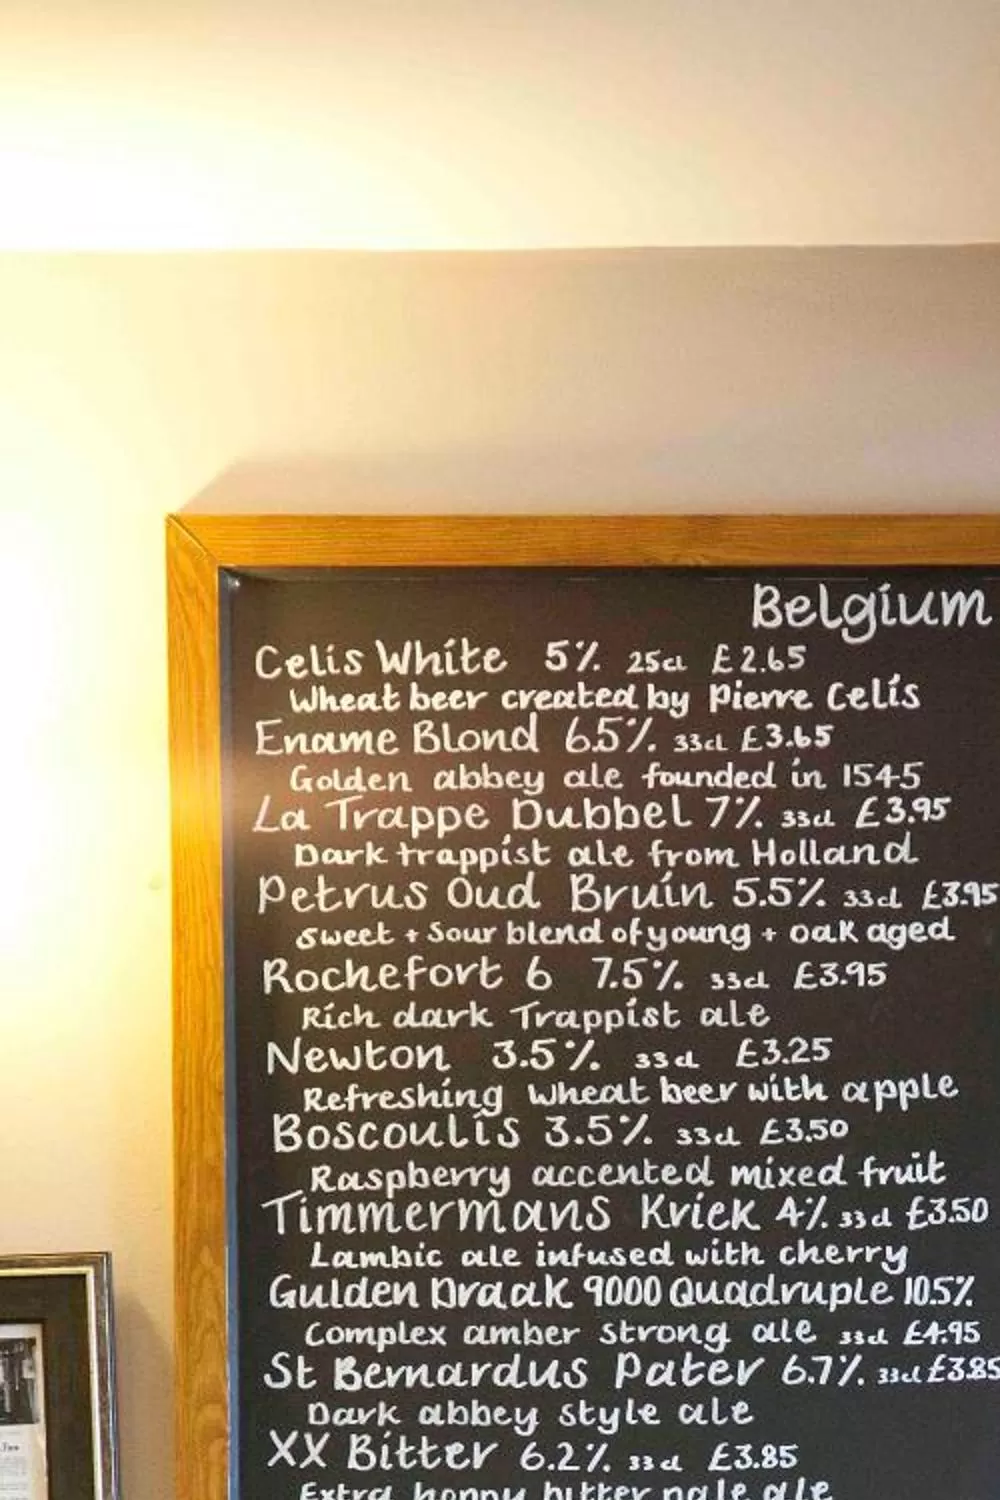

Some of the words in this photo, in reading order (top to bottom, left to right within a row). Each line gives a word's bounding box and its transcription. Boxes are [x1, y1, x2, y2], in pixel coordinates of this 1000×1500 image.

[752, 583, 992, 644] Belgium
[256, 644, 364, 679] Celis
[375, 637, 508, 676] White
[545, 640, 600, 672] 5%
[410, 682, 488, 711] beer
[501, 681, 639, 710] created
[256, 719, 399, 755] Ename
[414, 712, 539, 754] Blond
[741, 723, 834, 752] £3.65
[290, 765, 412, 792] Golden
[642, 761, 777, 789] founded
[844, 761, 924, 790] 1545
[254, 795, 310, 832] La
[325, 795, 489, 839] Trappe
[512, 794, 692, 831] Dubbel
[705, 795, 763, 829] 7%
[855, 796, 951, 829] £3.95
[397, 834, 551, 875] trappist
[752, 831, 919, 866] Holland
[259, 875, 428, 913] Petrus
[447, 871, 541, 909] Oud
[570, 871, 714, 912] Bruin
[922, 880, 1000, 910] £3.95
[507, 918, 604, 945] blend
[264, 955, 503, 994] Rochefort
[592, 957, 683, 991] 7.5%
[794, 961, 887, 990] £3.95
[302, 1002, 381, 1030] Rich
[510, 997, 681, 1034] Trappist
[268, 1036, 451, 1074] Newton
[736, 1036, 833, 1068] £3.25
[304, 1077, 503, 1119] Refreshing
[842, 1072, 959, 1112] apple
[273, 1113, 520, 1153] Boscoulis
[760, 1117, 848, 1145] £3.50
[311, 1160, 511, 1199] Raspberry
[532, 1155, 714, 1188] accented
[730, 1154, 848, 1190] mixed
[261, 1190, 610, 1235] Timmermans
[642, 1192, 761, 1231] Kriek
[310, 1241, 443, 1269] Lambic
[536, 1240, 674, 1267] infused
[779, 1238, 908, 1275] cherry
[270, 1274, 419, 1309] Gulden
[583, 1275, 662, 1307] 9000
[670, 1273, 894, 1312] Quadruple
[305, 1321, 447, 1353] Complex
[463, 1319, 580, 1346] amber
[599, 1320, 731, 1354] strong
[903, 1320, 980, 1345] £4.95
[264, 1352, 317, 1389] St
[334, 1353, 588, 1392] Bernardus
[782, 1354, 864, 1387] 6.7%
[559, 1398, 661, 1435] style
[678, 1396, 754, 1425] ale
[268, 1430, 330, 1468] XX
[347, 1431, 498, 1471] Bitter
[520, 1442, 611, 1472] 6.2%
[708, 1442, 798, 1471] £3.85
